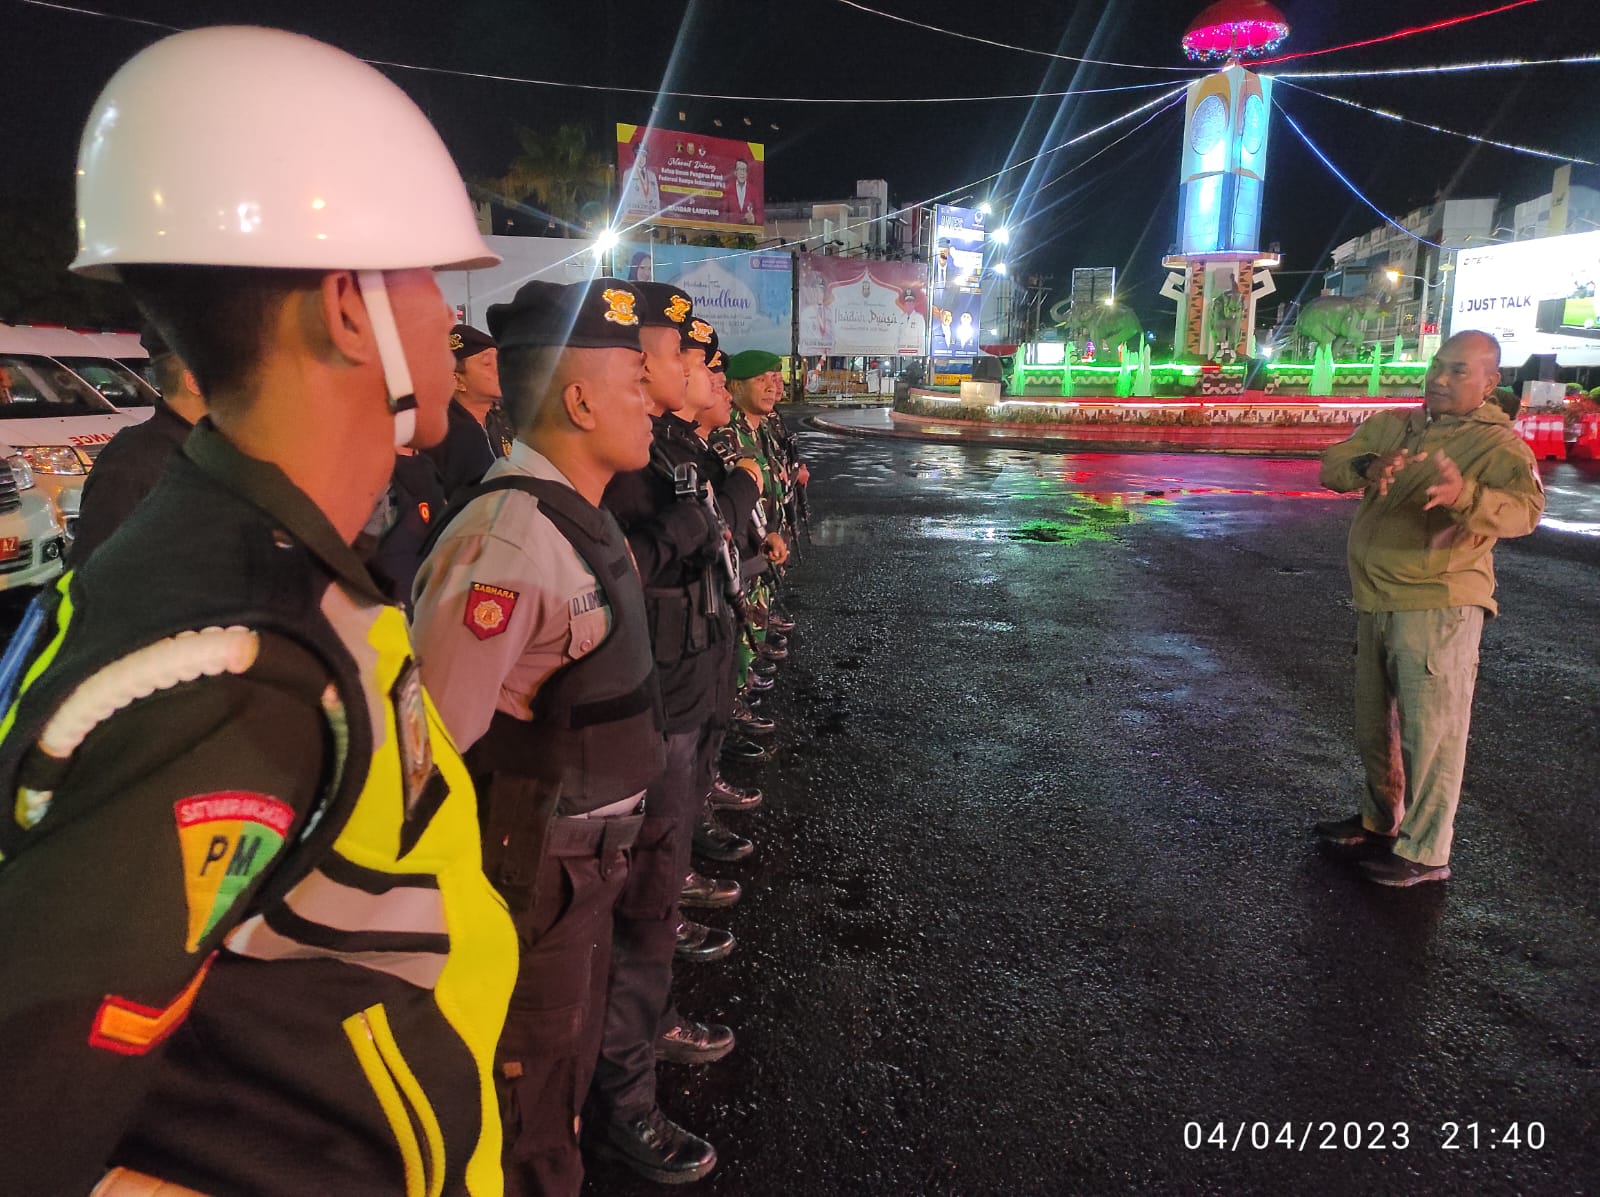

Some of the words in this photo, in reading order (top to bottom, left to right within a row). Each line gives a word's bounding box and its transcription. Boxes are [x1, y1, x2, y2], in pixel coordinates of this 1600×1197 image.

[692, 288, 751, 310] madhan
[1467, 298, 1496, 312] JUST
[1500, 296, 1531, 309] TALK
[473, 583, 515, 600] SABHARA
[199, 834, 263, 877] PM
